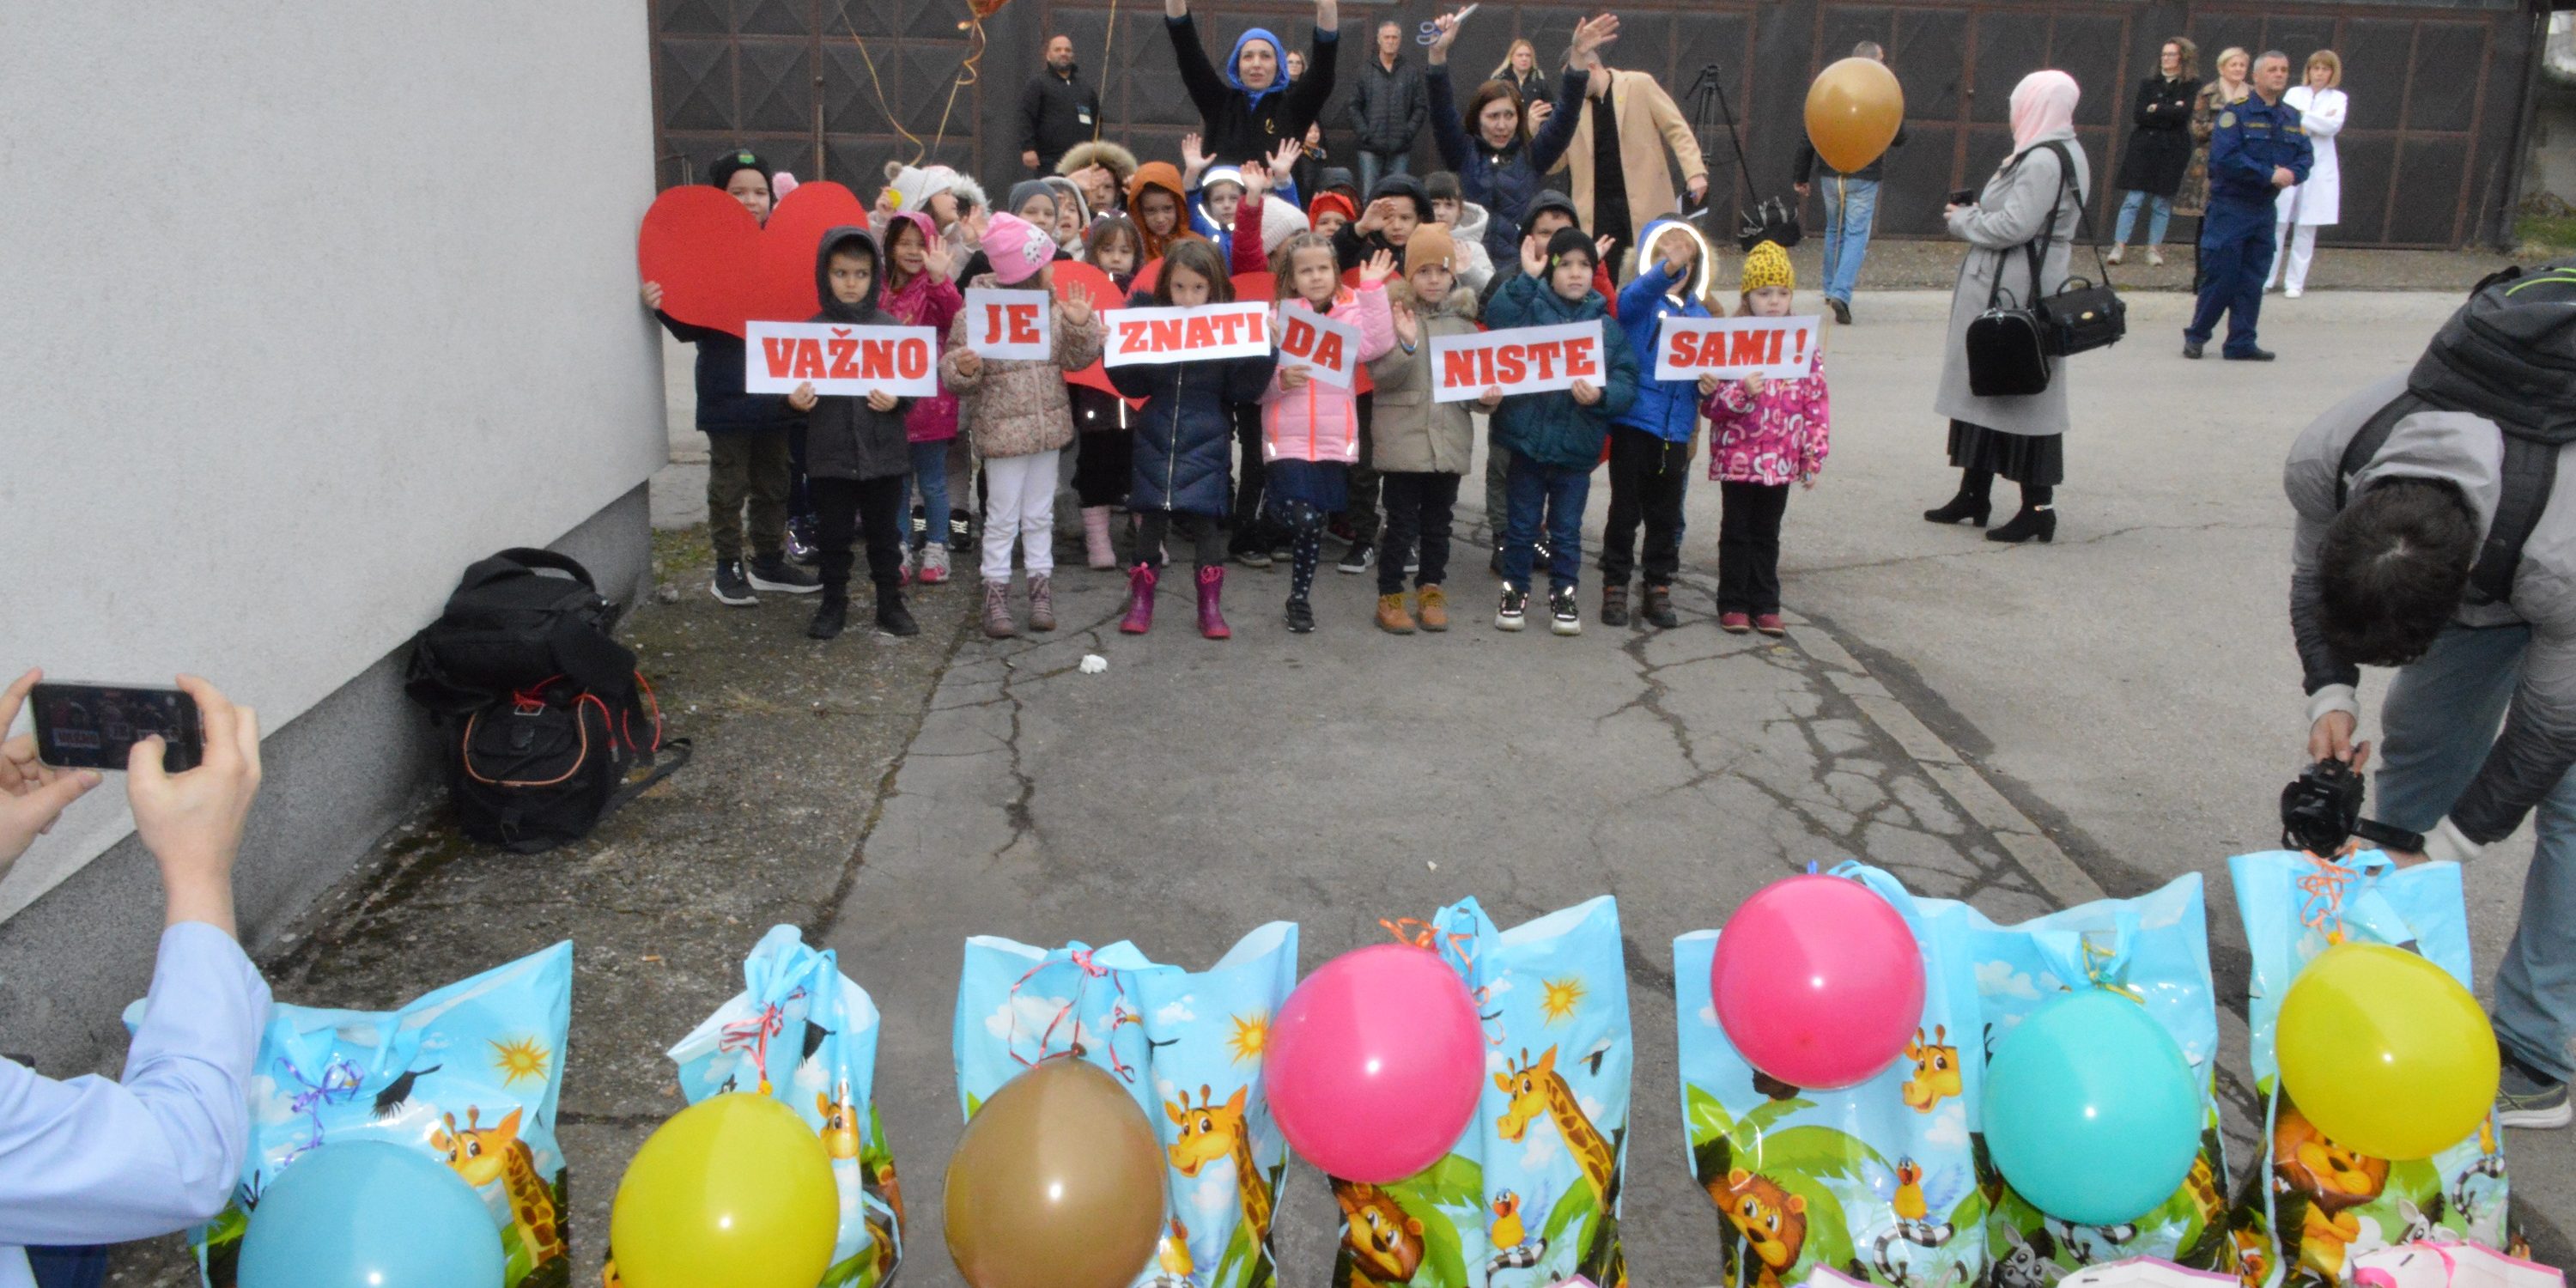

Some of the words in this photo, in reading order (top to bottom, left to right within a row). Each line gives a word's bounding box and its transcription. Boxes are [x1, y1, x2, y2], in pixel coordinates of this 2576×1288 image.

[985, 304, 1041, 344] JE
[1119, 312, 1265, 354] ZNATI
[1280, 316, 1343, 371] DA
[762, 327, 928, 380] VAŽNO
[1444, 337, 1597, 388] NISTE
